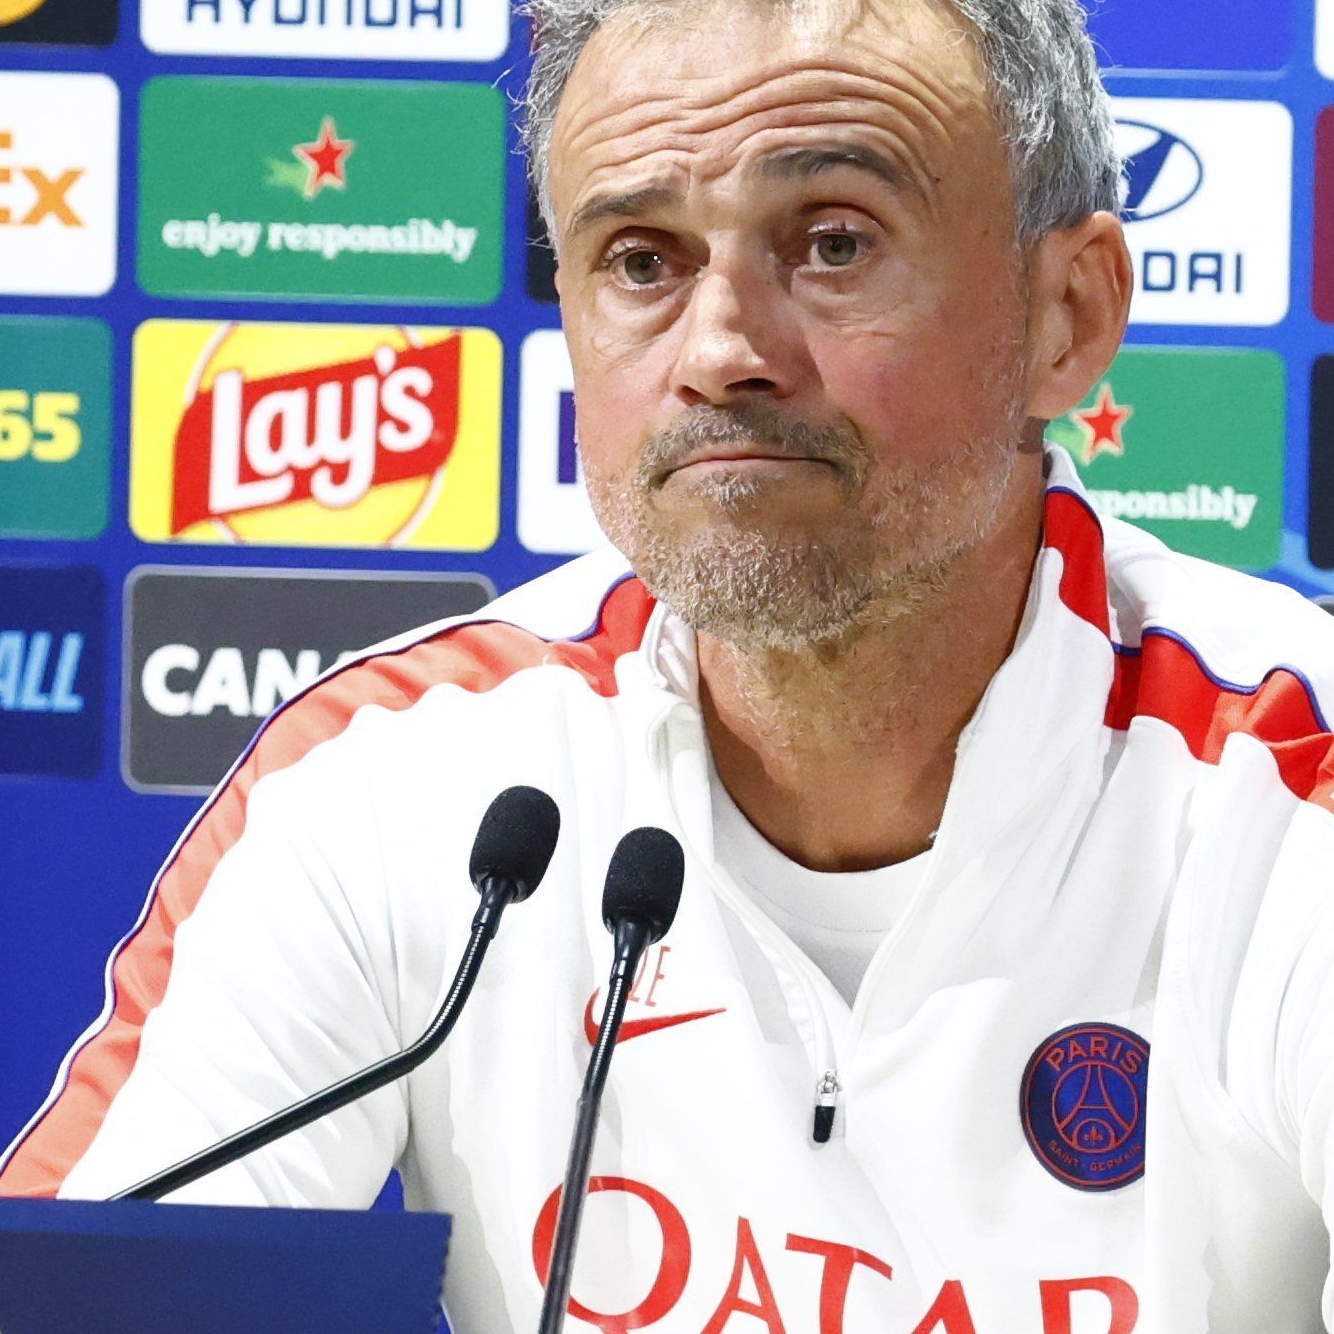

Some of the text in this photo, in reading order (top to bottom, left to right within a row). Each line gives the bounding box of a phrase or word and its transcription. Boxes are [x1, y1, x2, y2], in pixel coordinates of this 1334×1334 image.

[162, 213, 478, 263] enjoy responsibly
[208, 345, 435, 514] Lay's
[1088, 482, 1259, 531] sponsibly
[142, 643, 357, 717] CAN
[1046, 1036, 1145, 1074] PARIS
[1048, 1140, 1142, 1171] SAINT GERMAIN
